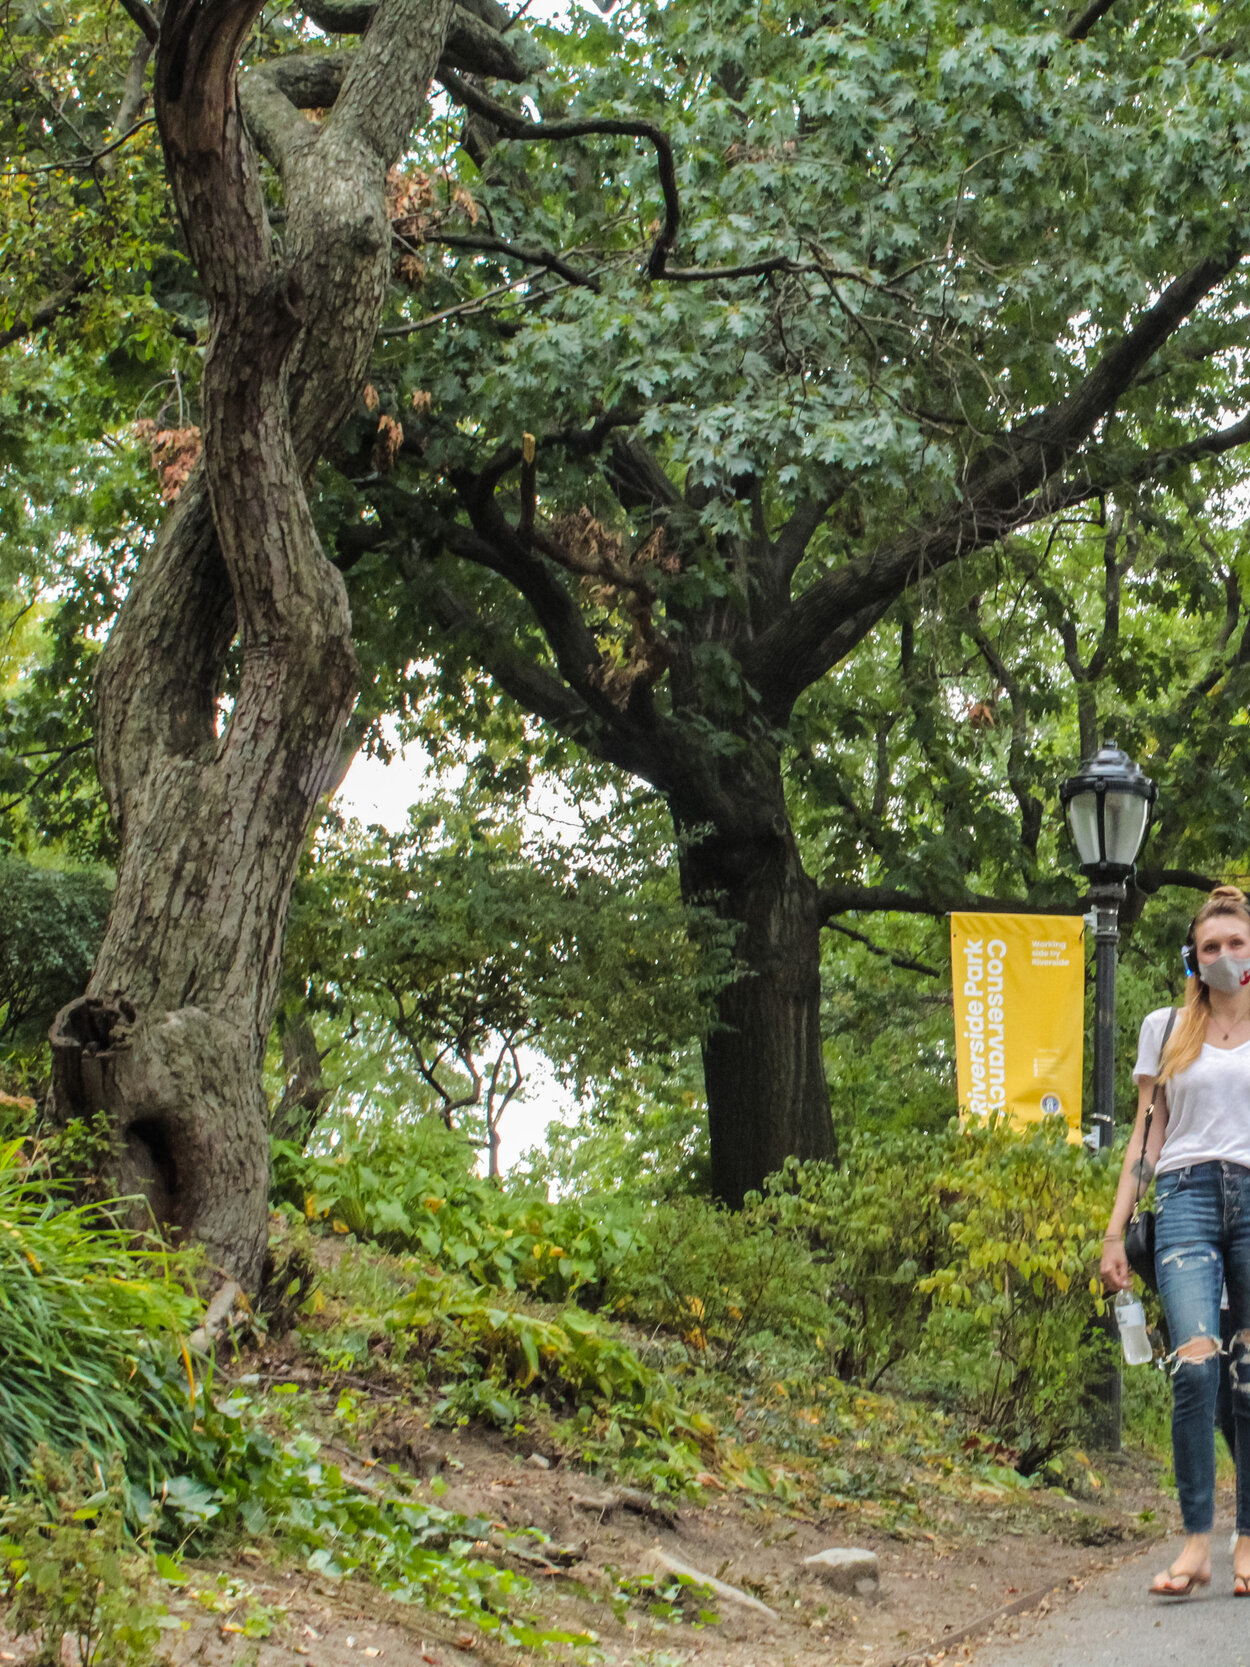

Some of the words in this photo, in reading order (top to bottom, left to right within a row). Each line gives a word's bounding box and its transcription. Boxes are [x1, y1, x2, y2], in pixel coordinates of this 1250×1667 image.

[1031, 940, 1067, 950] Working
[1031, 958, 1070, 967] Riverside
[1050, 950, 1061, 961] by
[963, 938, 984, 997] Park
[987, 938, 1008, 1118] Conservancy
[963, 999, 988, 1116] Riverside
